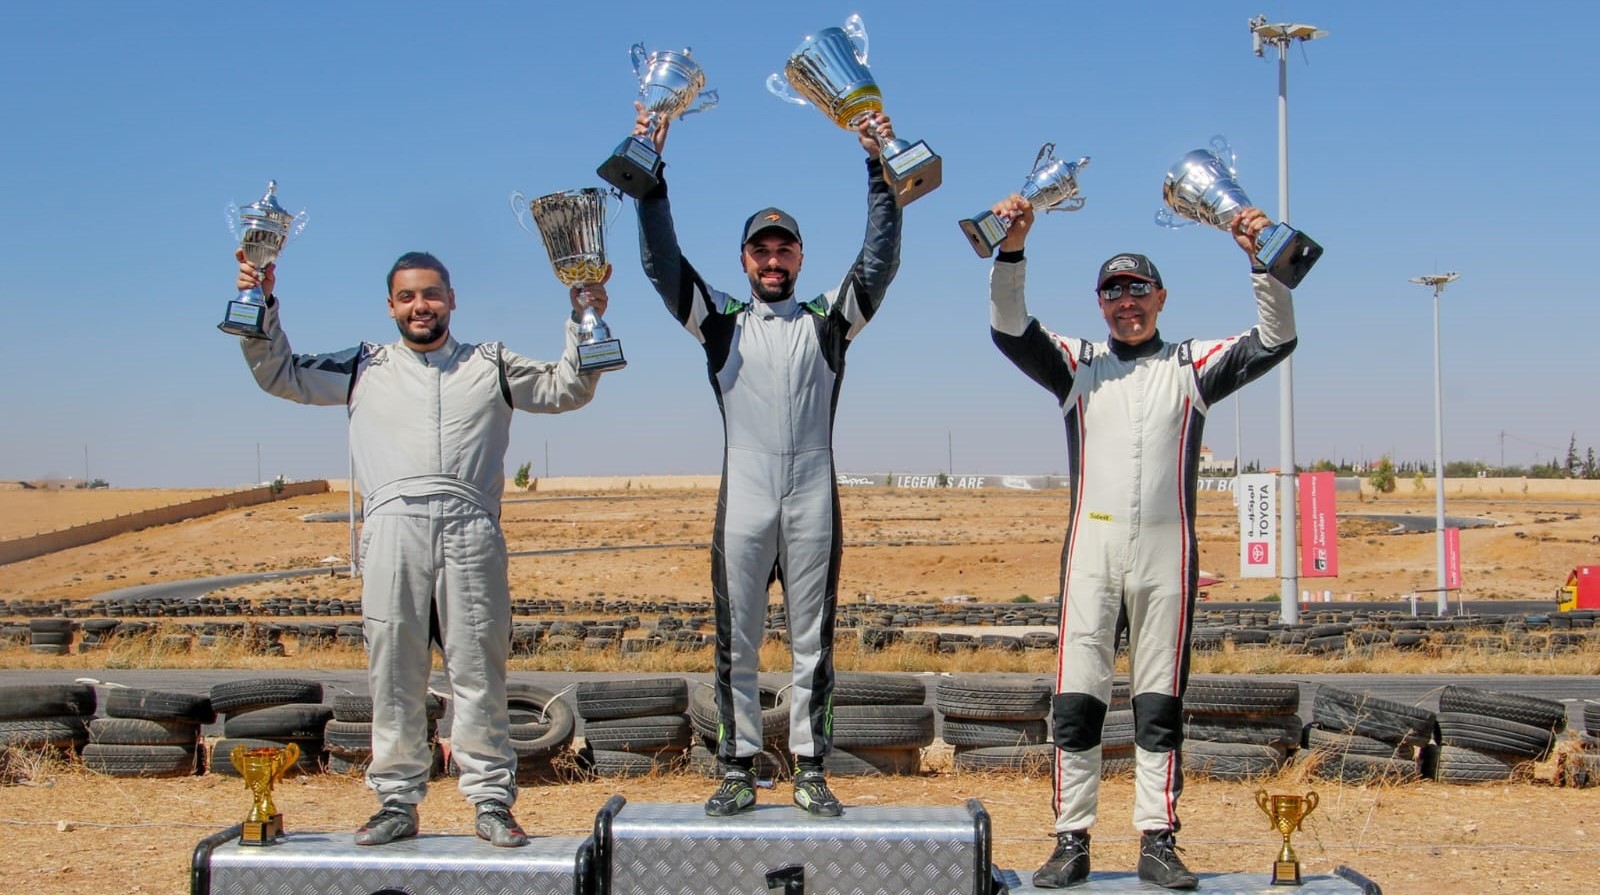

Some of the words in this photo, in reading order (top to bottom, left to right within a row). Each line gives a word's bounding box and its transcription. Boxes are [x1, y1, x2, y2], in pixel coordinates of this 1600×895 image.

[897, 476, 954, 489] LEGENS
[957, 477, 985, 489] ARE
[1259, 485, 1269, 538] TOYOTA
